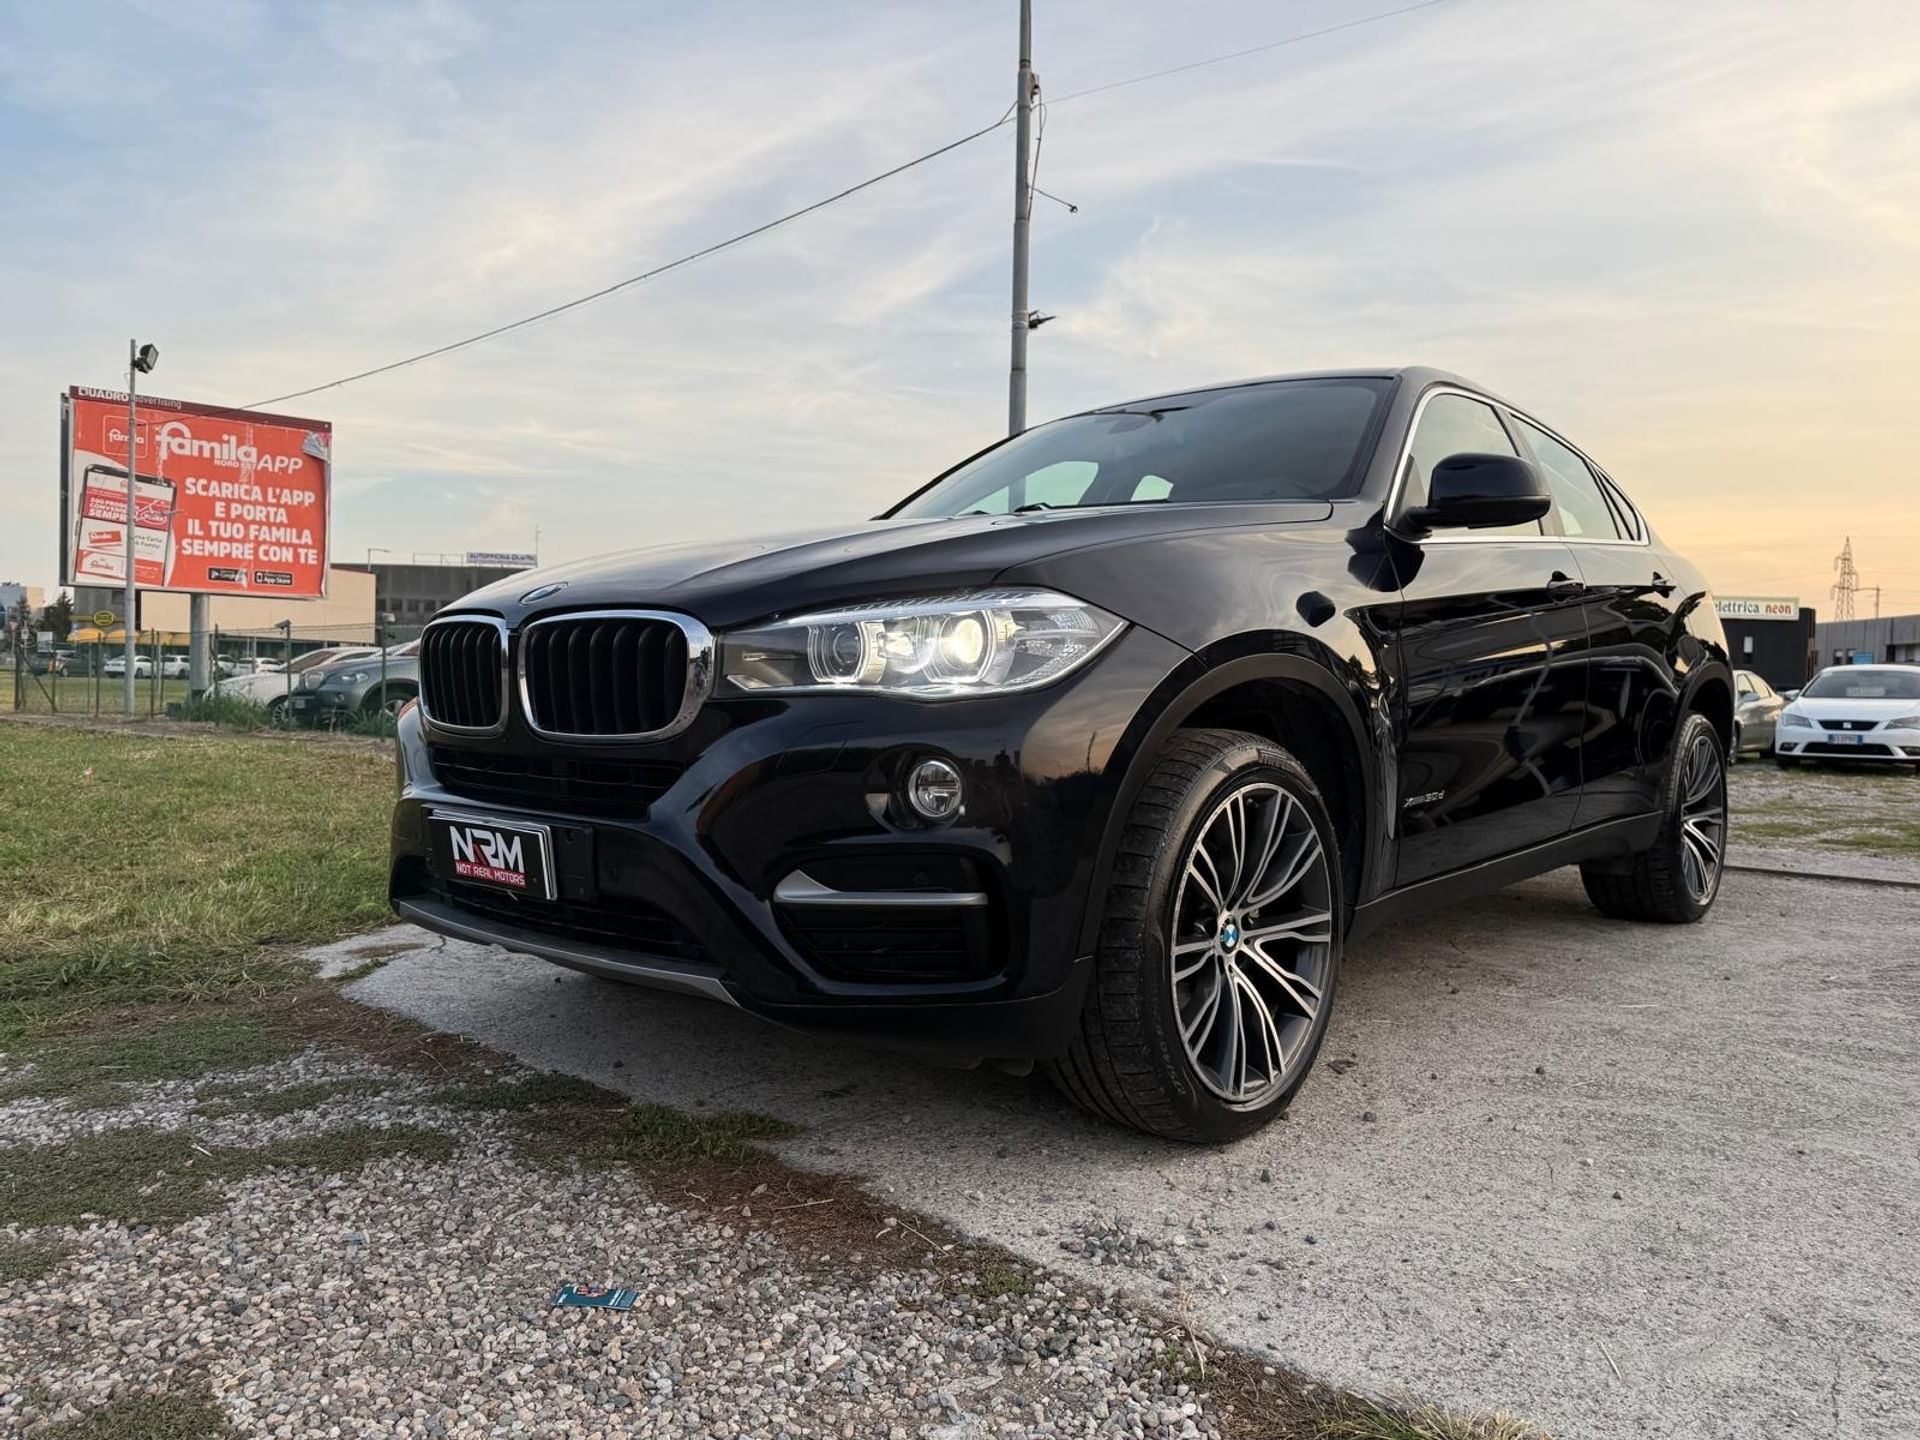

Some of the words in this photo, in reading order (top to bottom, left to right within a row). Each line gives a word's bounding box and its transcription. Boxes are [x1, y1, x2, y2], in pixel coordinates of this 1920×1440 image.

[155, 421, 258, 462] famila
[257, 454, 303, 474] APP
[185, 477, 262, 502] SCARICA
[267, 487, 316, 506] L'APP
[215, 501, 226, 518] E
[230, 503, 288, 523] PORTA
[187, 518, 204, 536] IL
[208, 520, 245, 539] TUO
[249, 524, 313, 545] FAMILA
[181, 538, 254, 560] SEMPRE
[258, 544, 293, 563] CON
[297, 547, 318, 565] TE
[1765, 603, 1792, 614] neon
[450, 825, 525, 873] NRM
[455, 861, 471, 874] NOT
[473, 866, 493, 879] REAL
[494, 870, 526, 885] MOTORS
